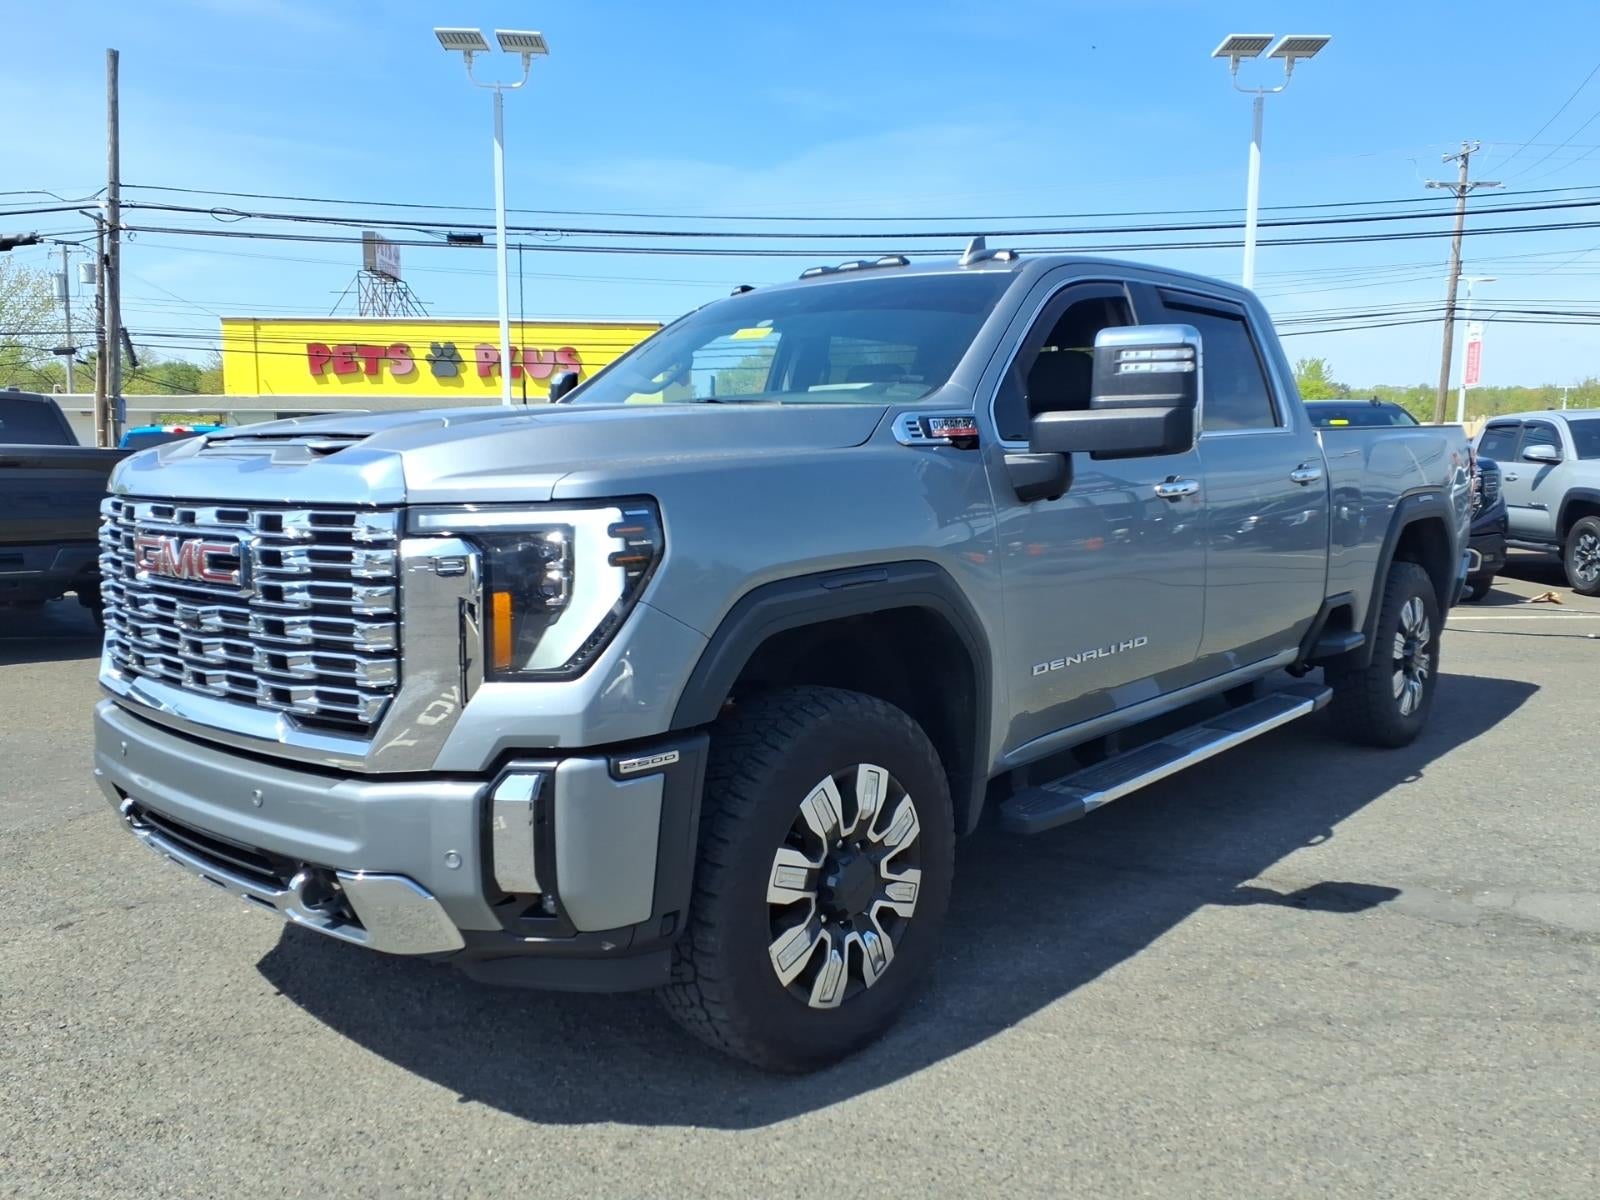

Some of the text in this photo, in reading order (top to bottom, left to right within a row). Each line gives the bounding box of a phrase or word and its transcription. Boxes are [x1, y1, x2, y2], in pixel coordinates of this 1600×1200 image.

[306, 342, 581, 379] PETS PLUS
[136, 536, 240, 586] GMC
[1032, 636, 1149, 676] DENALI HD
[622, 754, 676, 770] 2500
